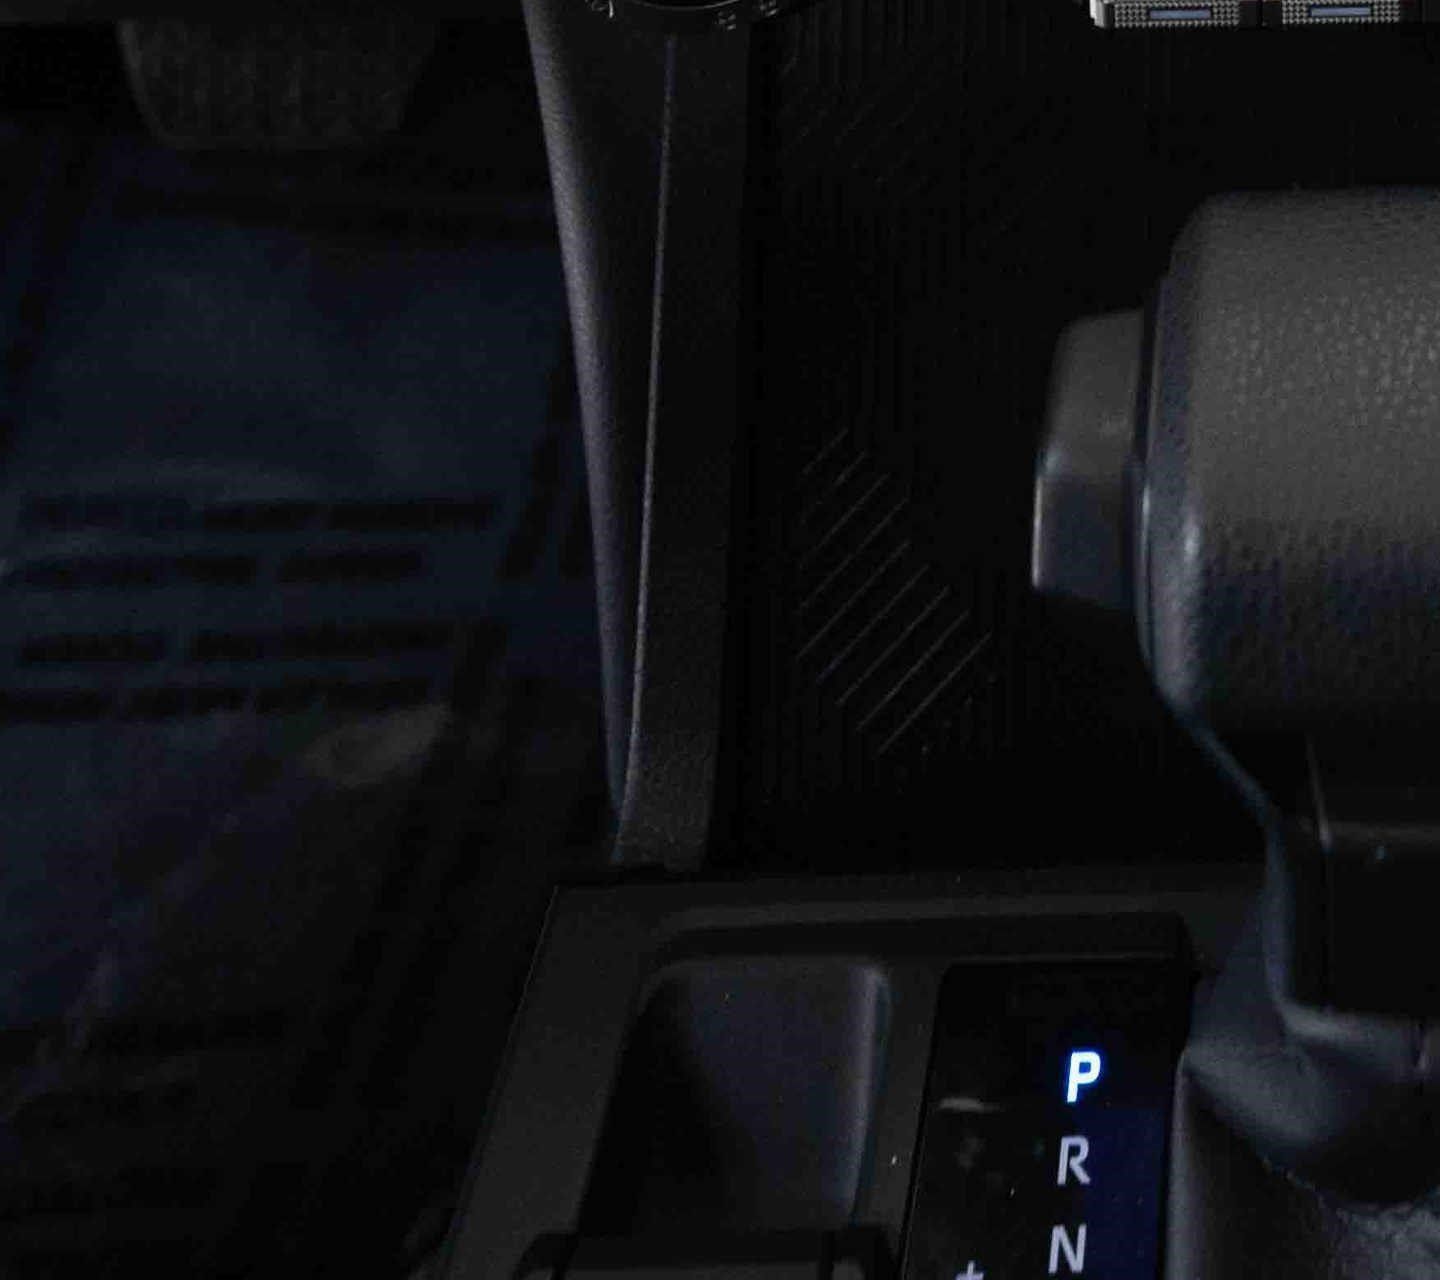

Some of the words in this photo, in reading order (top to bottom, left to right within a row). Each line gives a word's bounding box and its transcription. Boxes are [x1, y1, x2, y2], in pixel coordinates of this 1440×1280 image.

[1067, 1050, 1101, 1104] P
[1057, 1136, 1091, 1185] R
[1048, 1224, 1087, 1274] N
